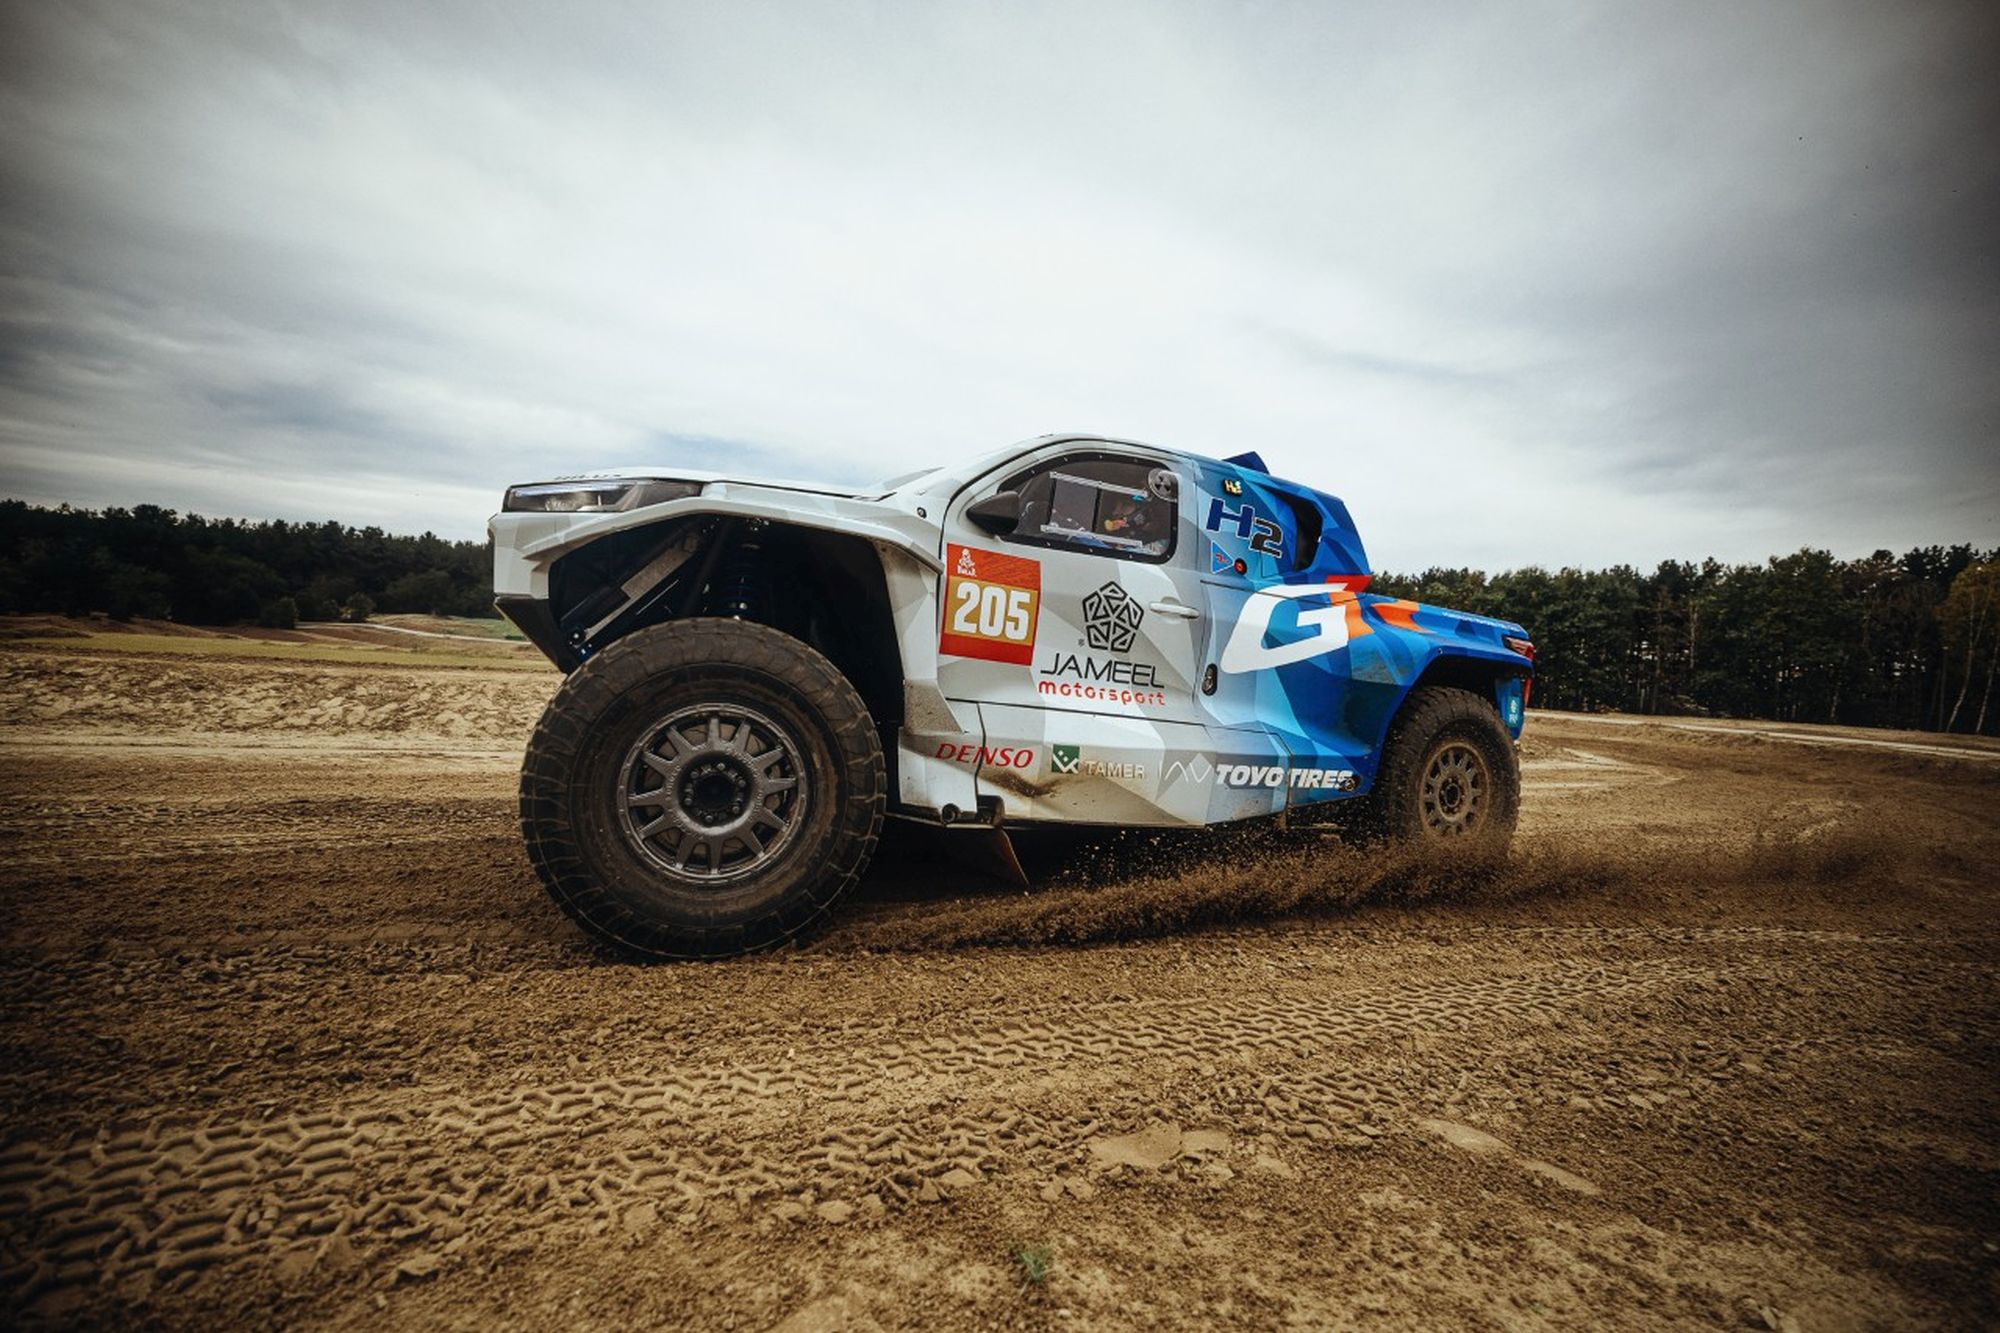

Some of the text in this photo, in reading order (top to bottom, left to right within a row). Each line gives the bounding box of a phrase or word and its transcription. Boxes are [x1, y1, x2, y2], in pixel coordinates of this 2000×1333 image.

[1206, 497, 1284, 558] H2
[953, 581, 1030, 640] 205
[1040, 652, 1165, 689] JAMEEL
[1038, 680, 1166, 706] motorsport
[935, 743, 1034, 768] DENSO
[1085, 760, 1145, 779] TAMER
[1215, 763, 1354, 790] TOYO TIRES
